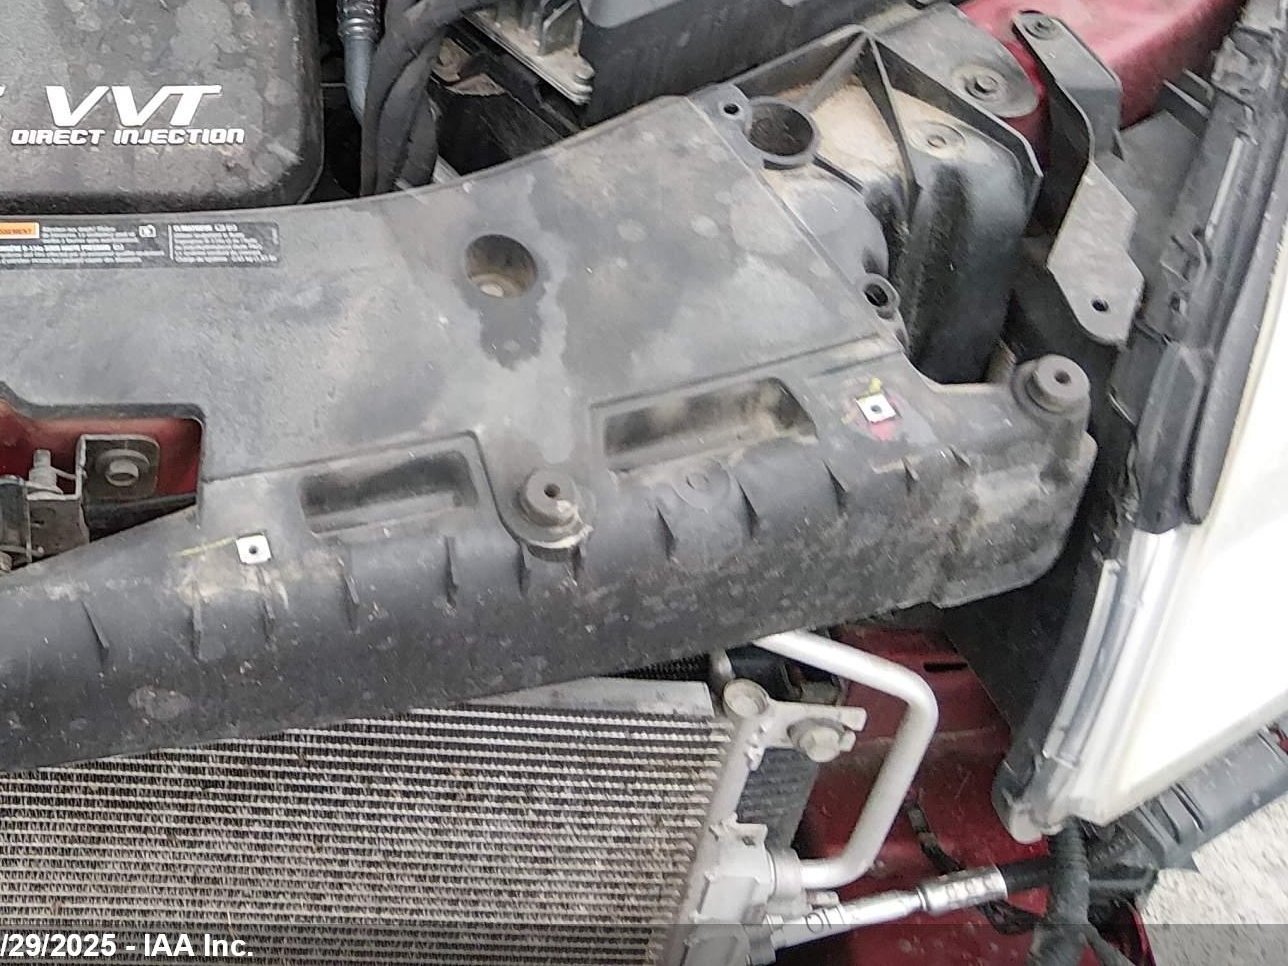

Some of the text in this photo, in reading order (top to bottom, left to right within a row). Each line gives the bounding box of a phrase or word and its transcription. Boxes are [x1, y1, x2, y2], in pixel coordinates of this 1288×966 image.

[45, 84, 222, 127] VVT
[11, 128, 246, 146] DIRECT INJECTION
